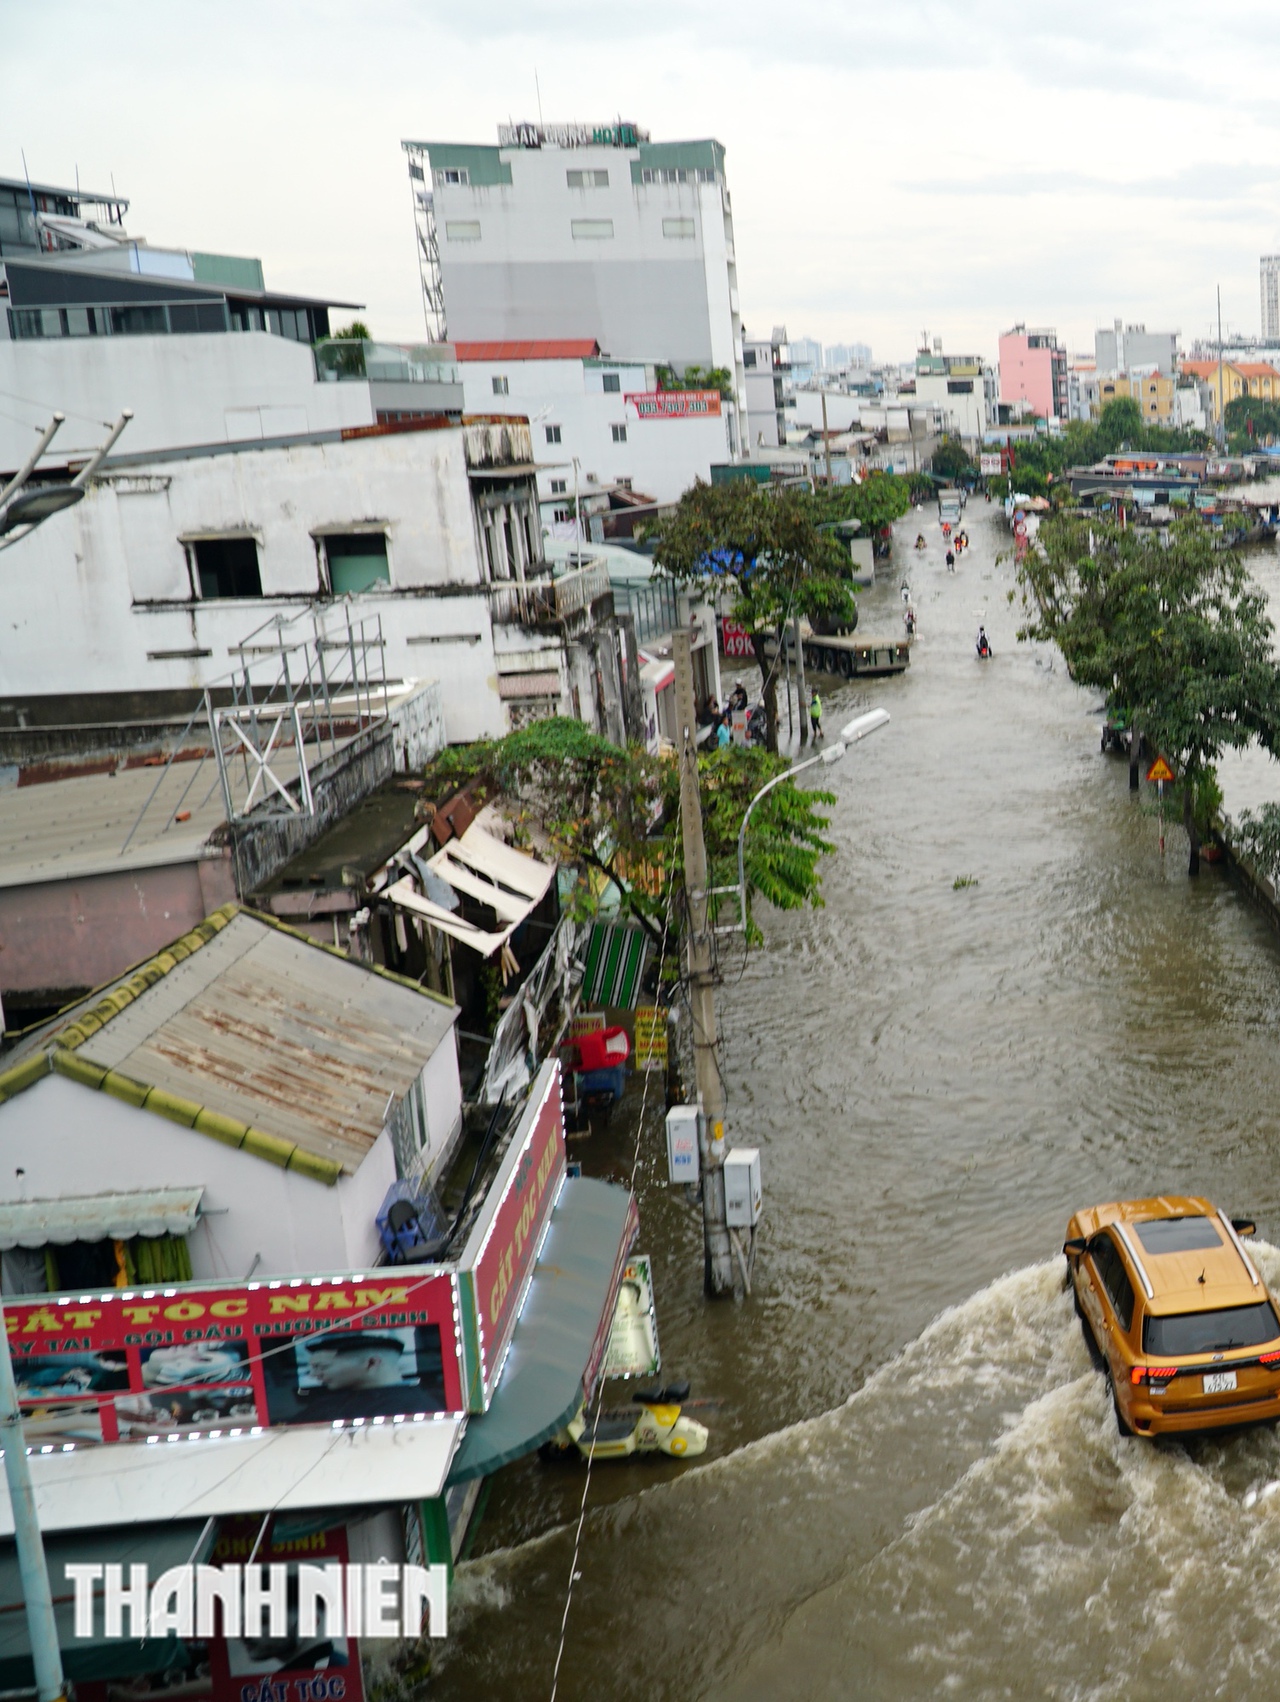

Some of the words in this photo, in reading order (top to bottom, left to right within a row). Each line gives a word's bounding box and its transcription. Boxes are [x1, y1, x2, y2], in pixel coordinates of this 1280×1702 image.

[592, 125, 637, 145] HOTEL
[727, 636, 756, 655] 49K
[536, 1123, 559, 1199] NAM
[122, 1298, 248, 1325] TÓC
[269, 1286, 408, 1315] NAM
[44, 1337, 91, 1352] TAI
[361, 1310, 428, 1327] SINH
[294, 1671, 346, 1702] TÓC
